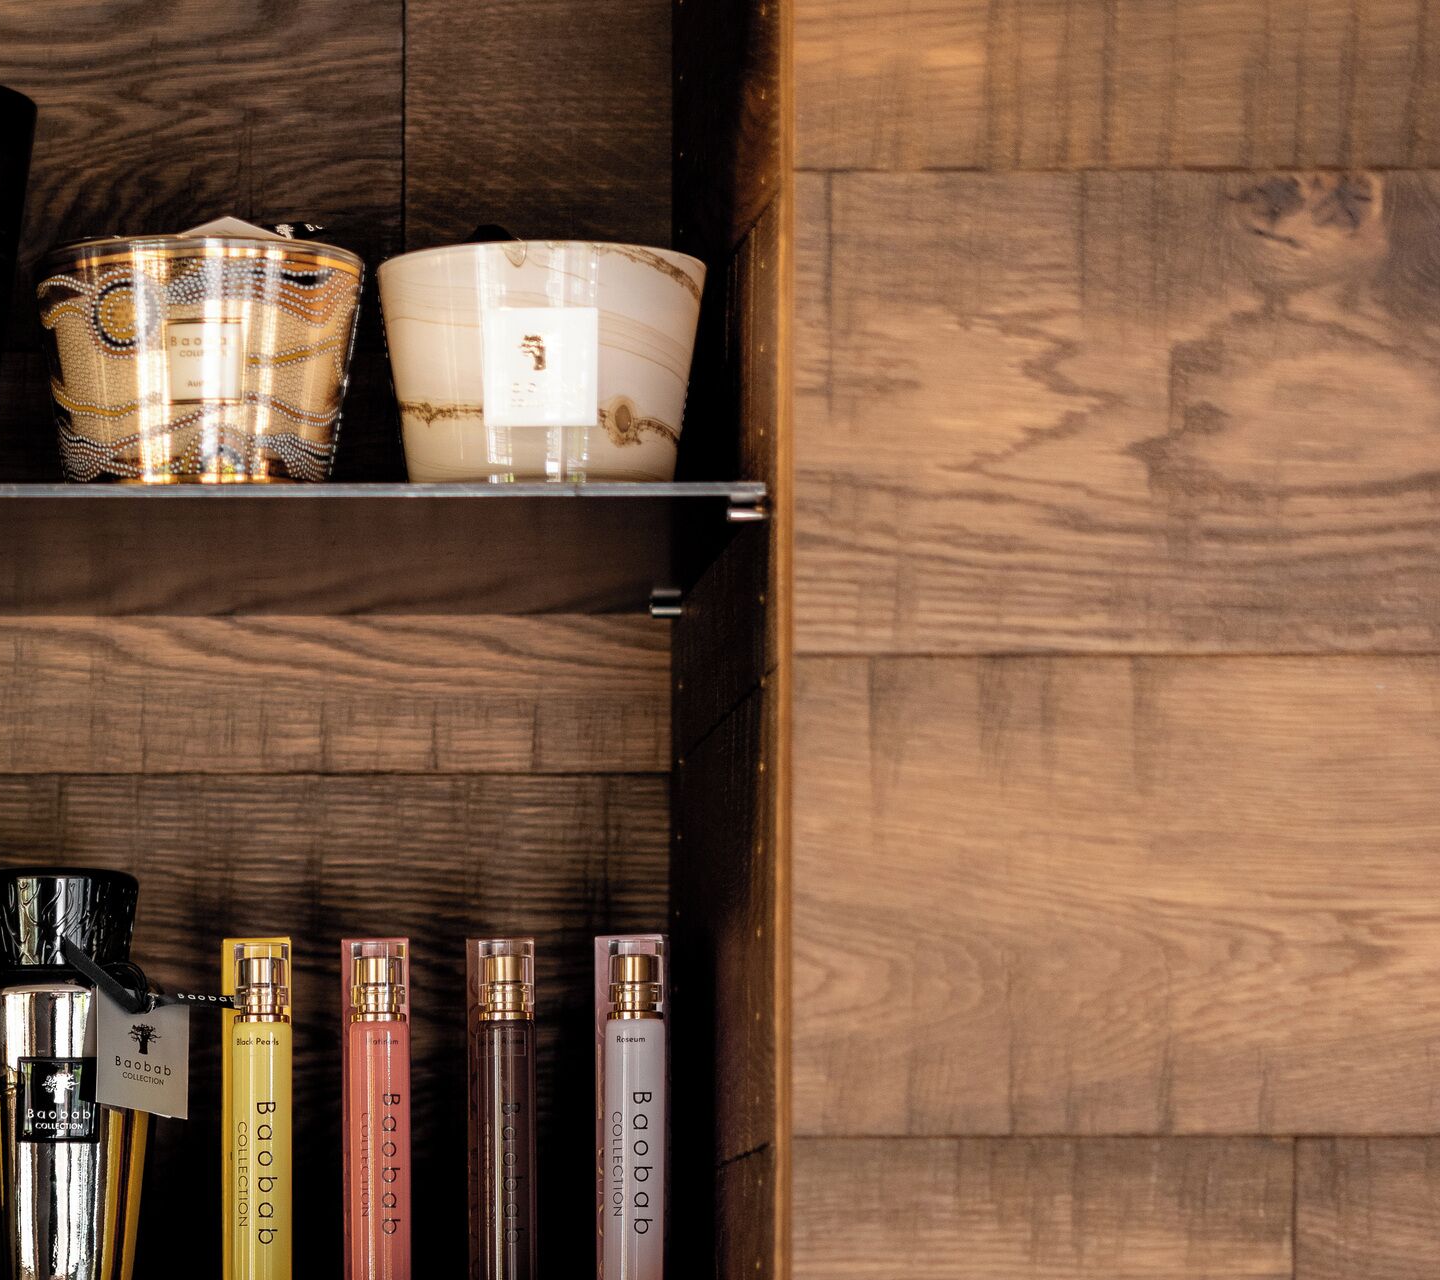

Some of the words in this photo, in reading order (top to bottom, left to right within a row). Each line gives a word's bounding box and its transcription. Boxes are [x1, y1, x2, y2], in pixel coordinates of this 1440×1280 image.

[115, 1055, 172, 1076] Baobab
[122, 1071, 165, 1086] COLLECTION
[236, 1037, 253, 1046] Black
[616, 1035, 646, 1043] Roseum
[27, 1108, 91, 1120] Baobab
[382, 1094, 401, 1234] Baobab
[612, 1111, 624, 1217] COLLECTION
[633, 1092, 653, 1234] Baobab
[238, 1121, 248, 1227] COLLECTION
[256, 1102, 278, 1244] Baobab
[503, 1102, 524, 1243] Baobab
